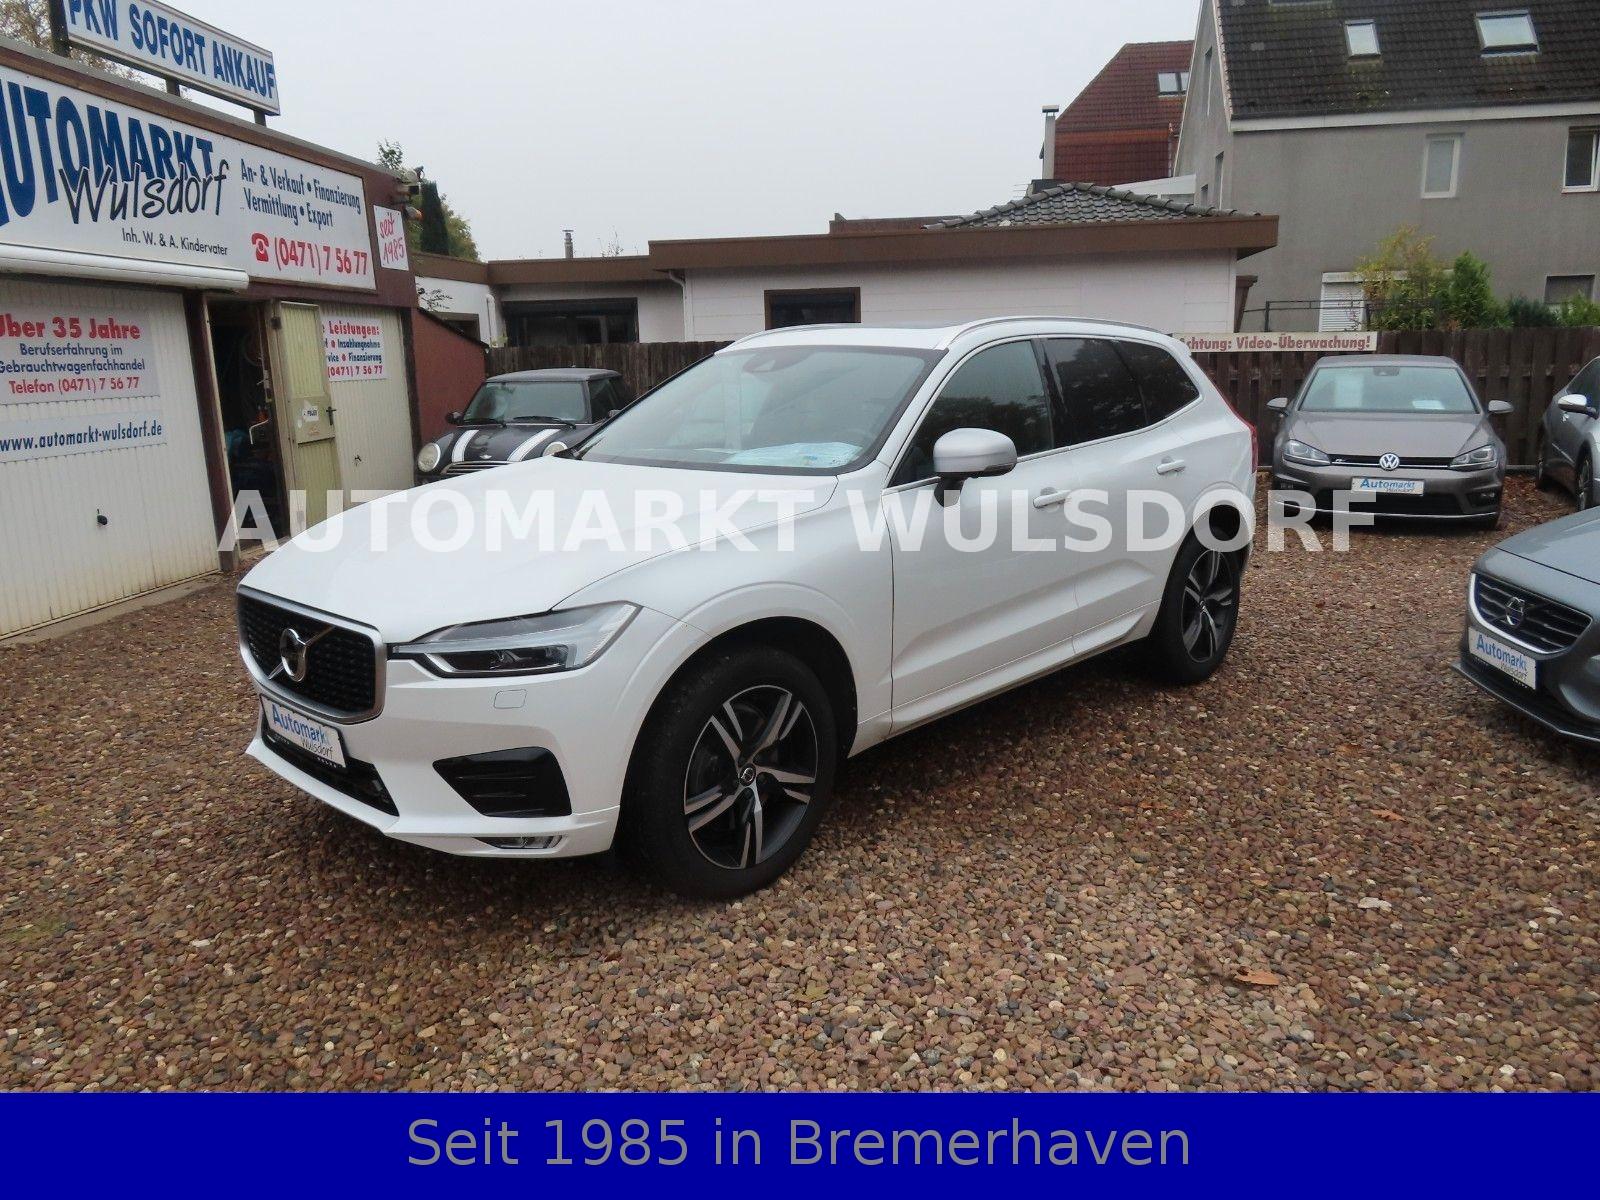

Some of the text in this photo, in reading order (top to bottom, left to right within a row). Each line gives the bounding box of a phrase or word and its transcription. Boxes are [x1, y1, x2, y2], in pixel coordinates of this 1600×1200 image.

[67, 0, 276, 99] PKW SOFORT ANKAUF
[0, 79, 214, 226] UTOMARKT
[58, 158, 230, 224] Wulsdorf
[240, 158, 362, 215] An- & Verkauf Finanzierung
[243, 186, 334, 231] Vermittlung Export
[121, 227, 228, 256] Inh. W. & A. Kindervater
[274, 237, 322, 275] (0471)
[335, 248, 351, 274] 56
[353, 251, 368, 276] 77
[52, 316, 82, 339] 35
[88, 317, 141, 340] Jahre
[328, 320, 381, 339] Leistungen:
[1180, 333, 1371, 351] chtung: Video-Überwachung!
[19, 342, 123, 358] Berufserfahrung im
[9, 376, 140, 395] Telefon (0471) 7 56 77
[0, 419, 162, 452] www.automarkt-wulsdorf.de
